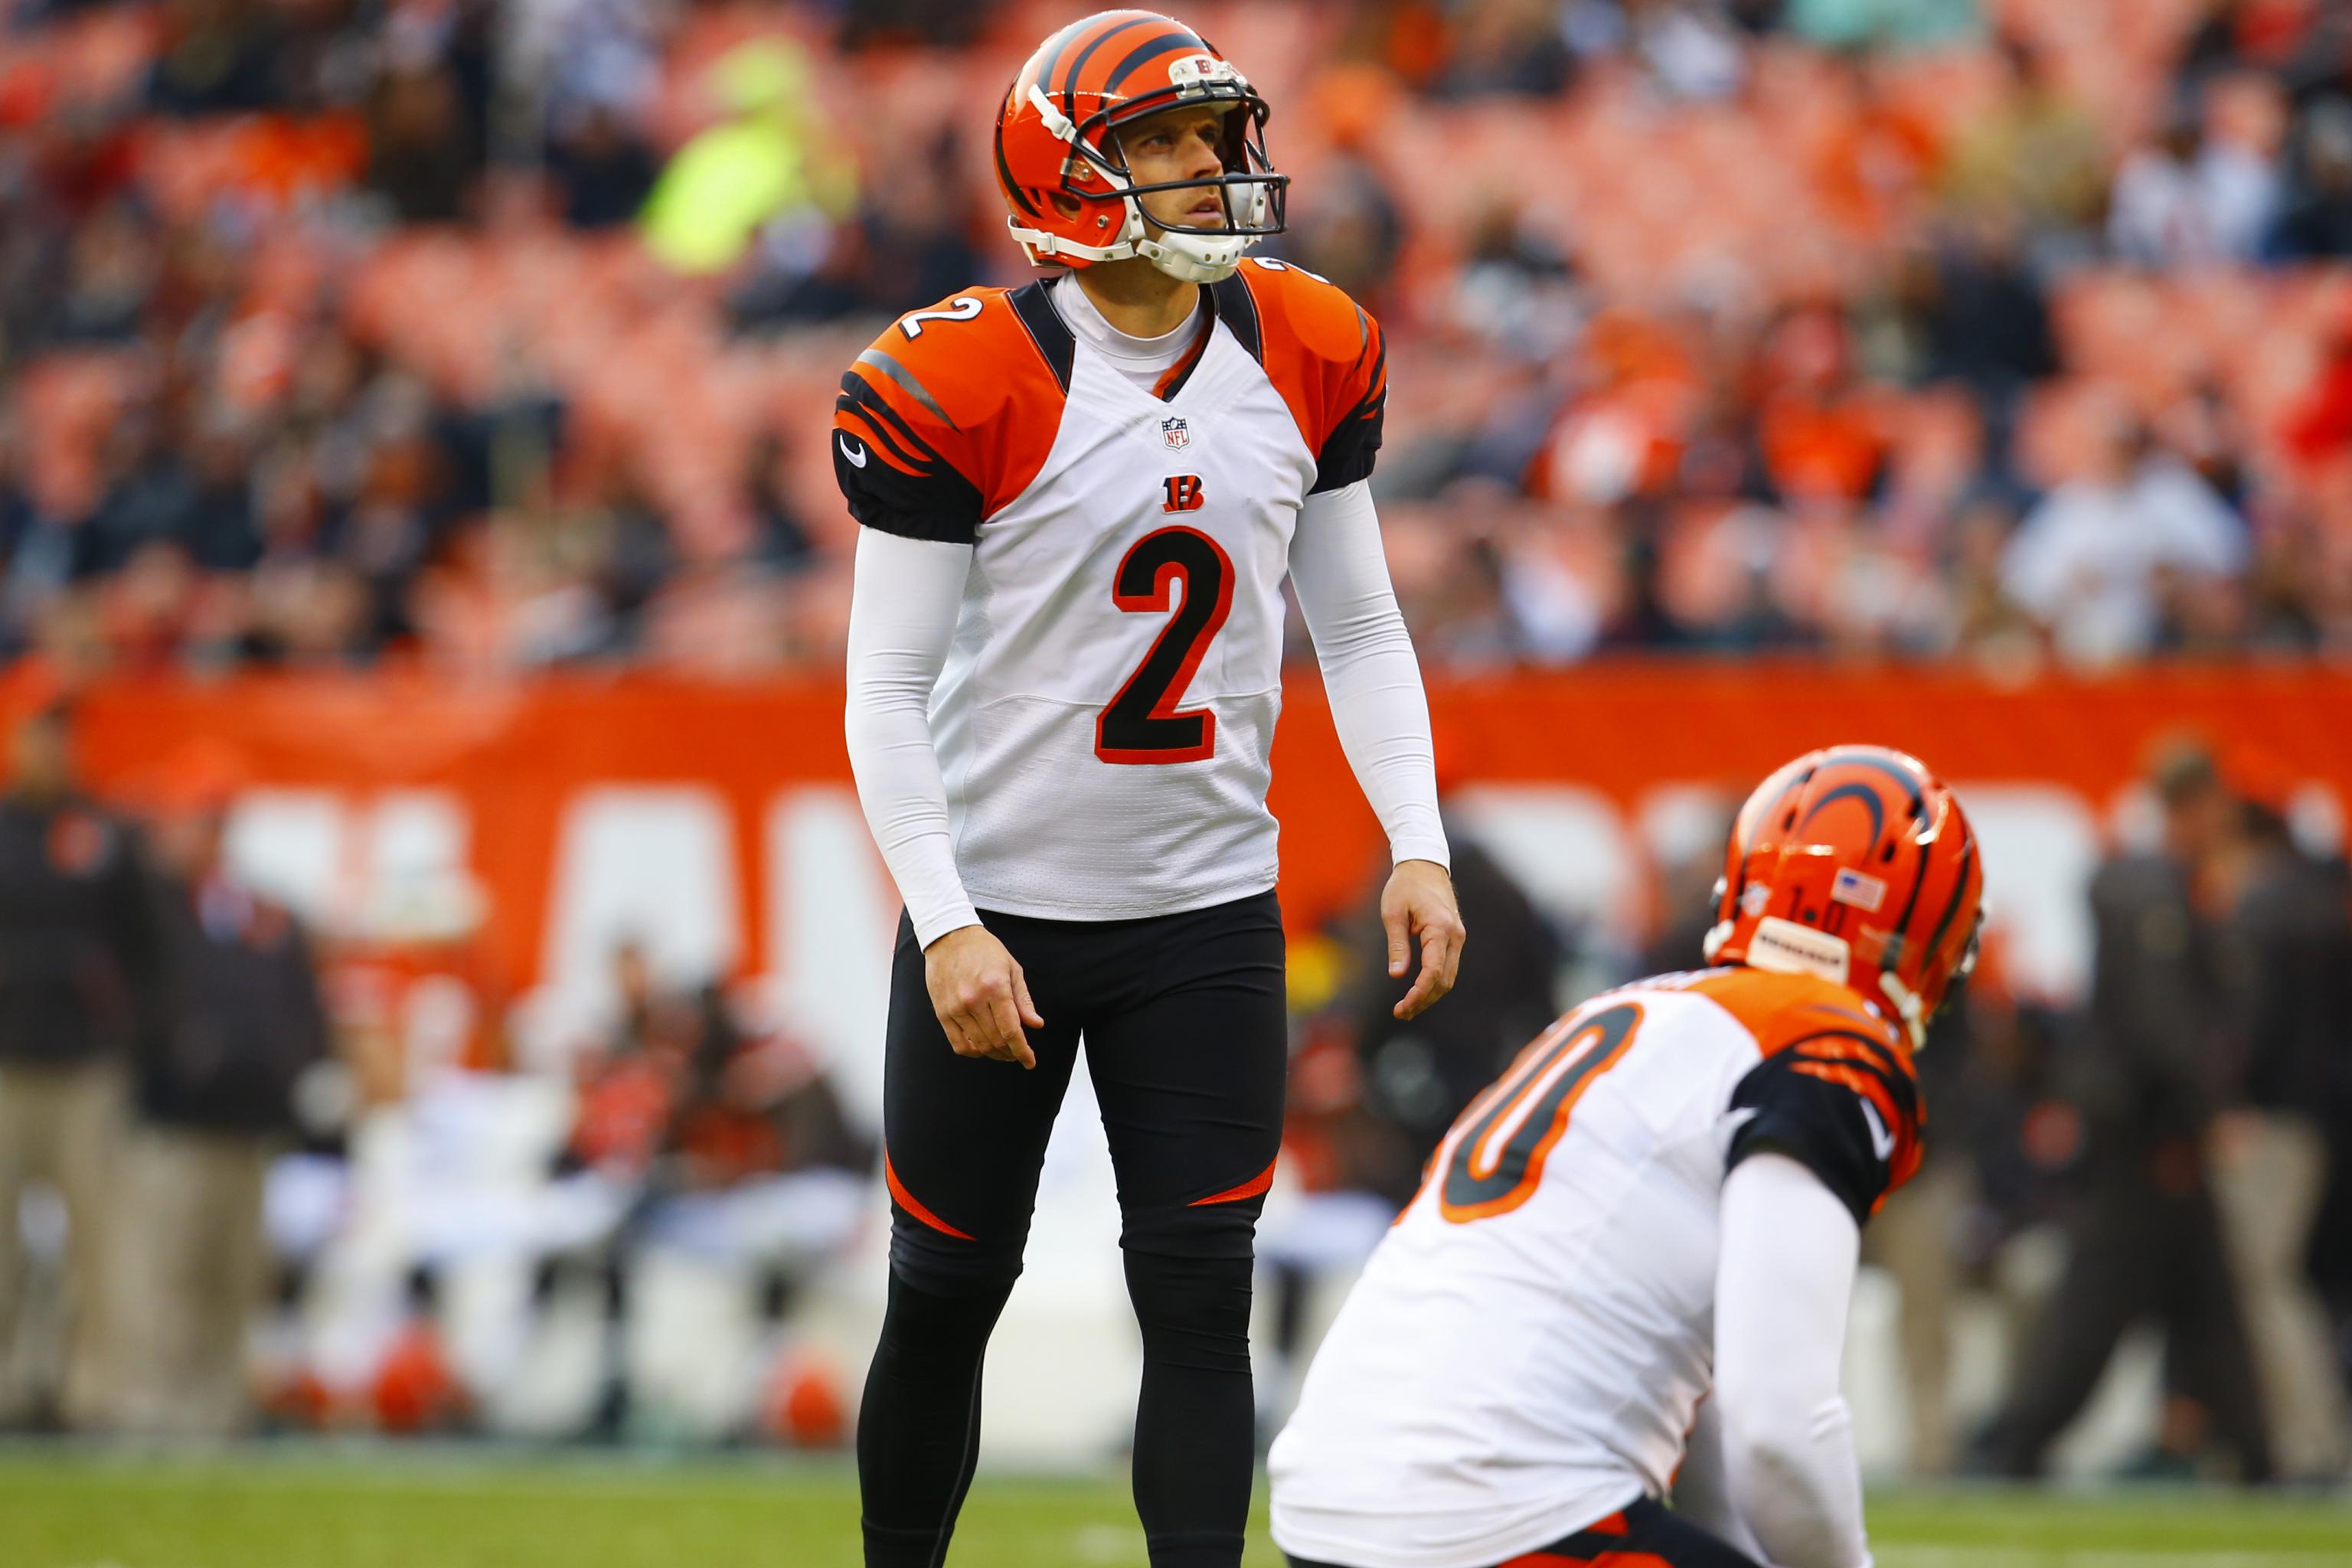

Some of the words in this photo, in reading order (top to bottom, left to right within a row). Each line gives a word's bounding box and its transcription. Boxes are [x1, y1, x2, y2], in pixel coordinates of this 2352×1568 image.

[898, 296, 984, 343] 2
[1166, 430, 1188, 446] NFL
[1162, 474, 1205, 513] B
[1094, 524, 1236, 765] 2
